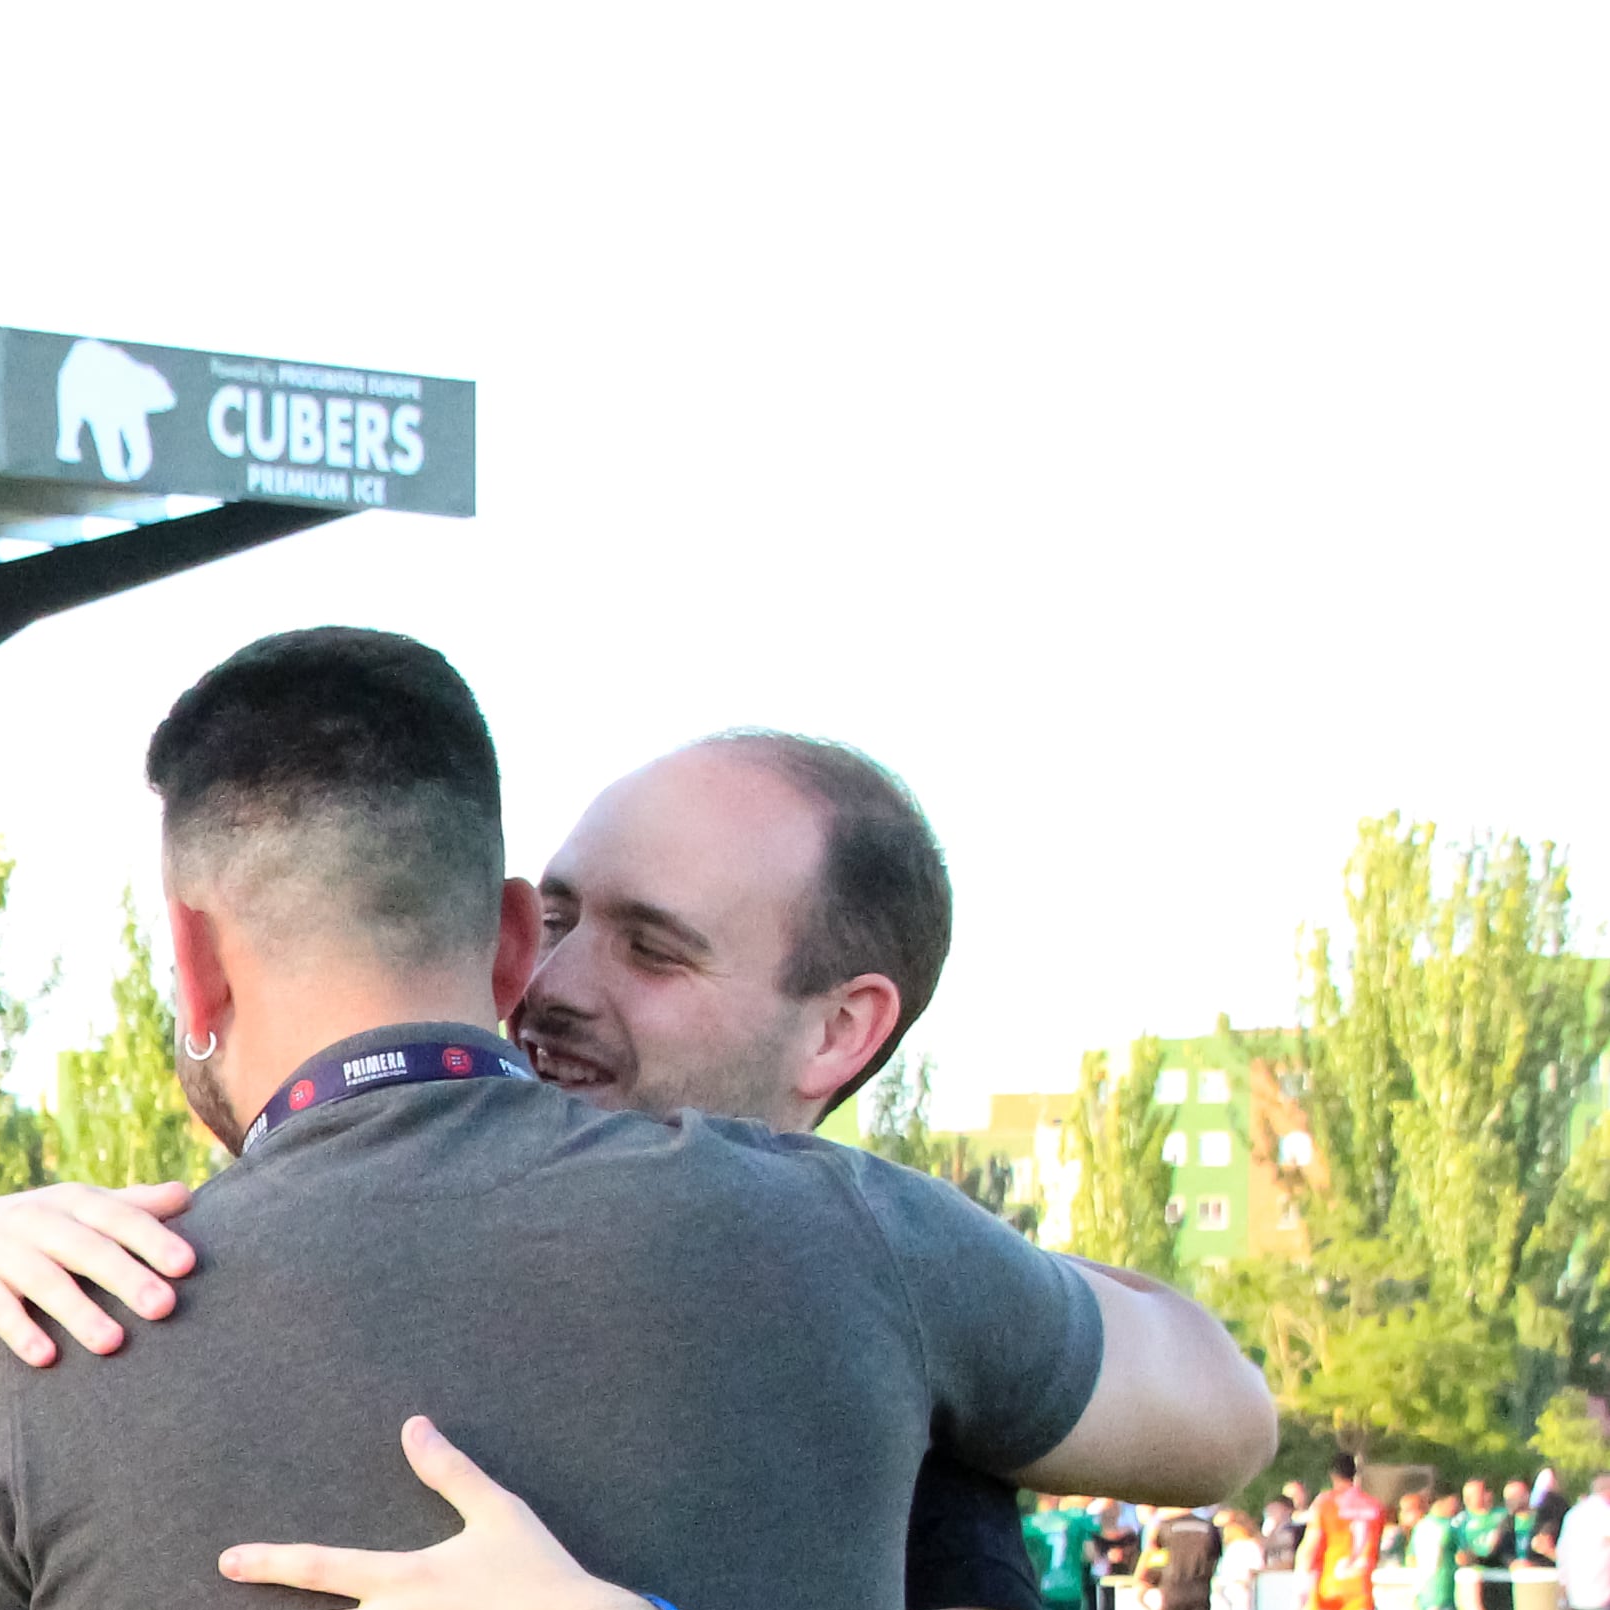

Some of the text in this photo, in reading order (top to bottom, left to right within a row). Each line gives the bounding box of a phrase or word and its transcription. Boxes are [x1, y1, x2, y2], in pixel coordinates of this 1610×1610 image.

[207, 384, 425, 476] CUBERS
[246, 463, 348, 502] PREMIUM
[343, 1051, 406, 1080] PRIMERA
